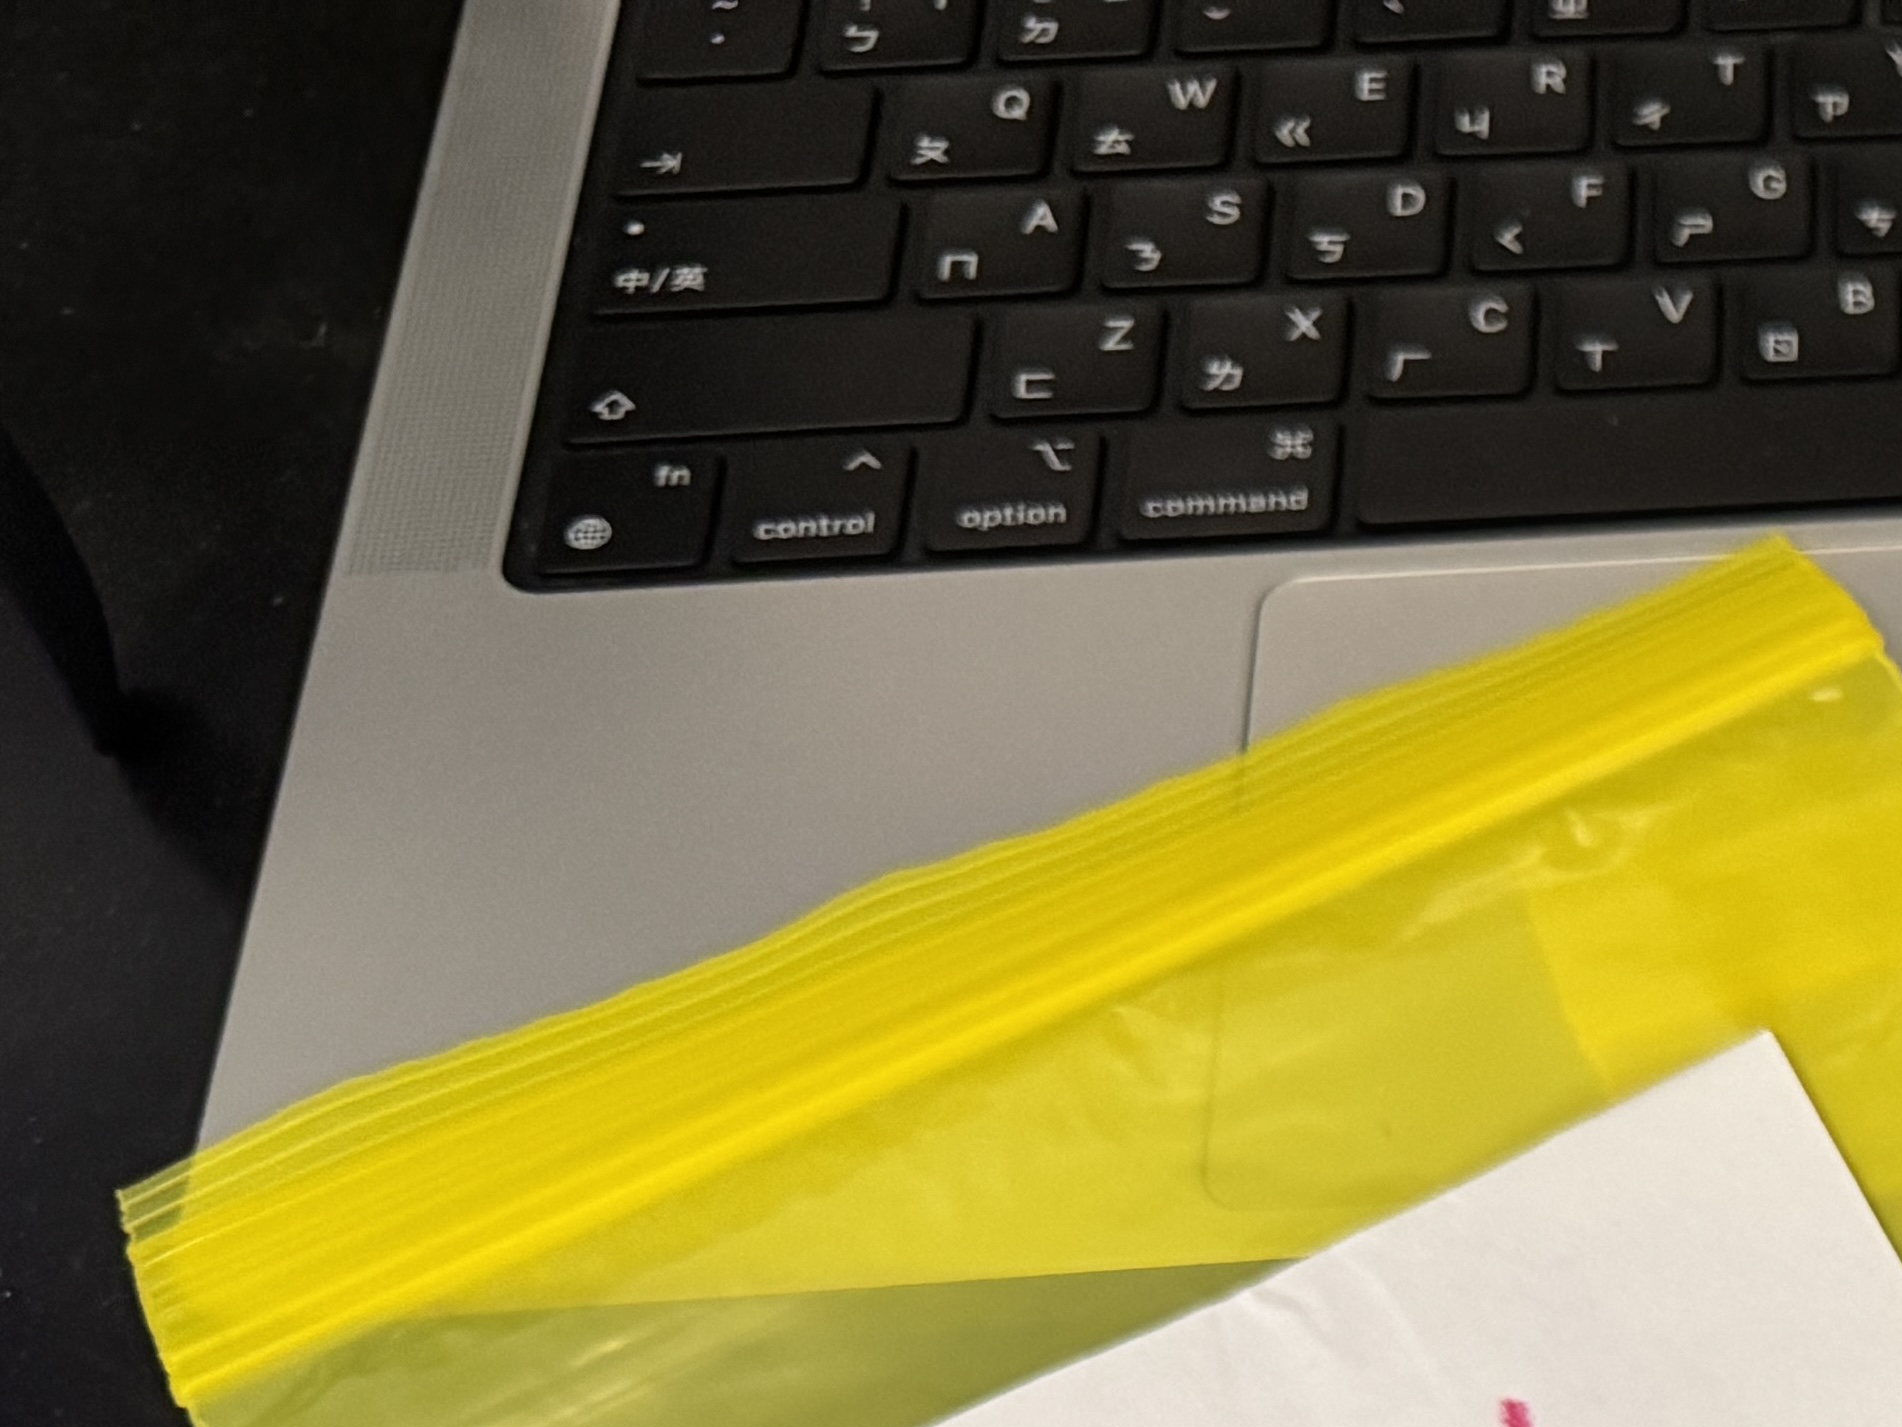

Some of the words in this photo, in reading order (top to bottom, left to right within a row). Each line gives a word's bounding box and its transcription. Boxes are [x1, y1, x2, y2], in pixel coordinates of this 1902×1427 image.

[1535, 63, 1566, 93] R
[1715, 54, 1743, 84] T
[1168, 79, 1216, 109] W
[1358, 71, 1385, 100] E
[994, 89, 1030, 119] Q
[1575, 176, 1602, 206] F
[1751, 167, 1786, 199] G
[1207, 194, 1240, 224] S
[1391, 185, 1425, 216] D
[1025, 202, 1057, 233] A
[615, 265, 707, 293] 中/英
[1656, 290, 1692, 323] V
[1841, 282, 1874, 314] B
[1288, 309, 1320, 340] X
[1471, 300, 1508, 332] C
[1101, 318, 1134, 350] Z
[656, 466, 690, 486] fn
[958, 503, 1066, 530] option
[1144, 489, 1308, 517] command
[754, 512, 875, 540] control
